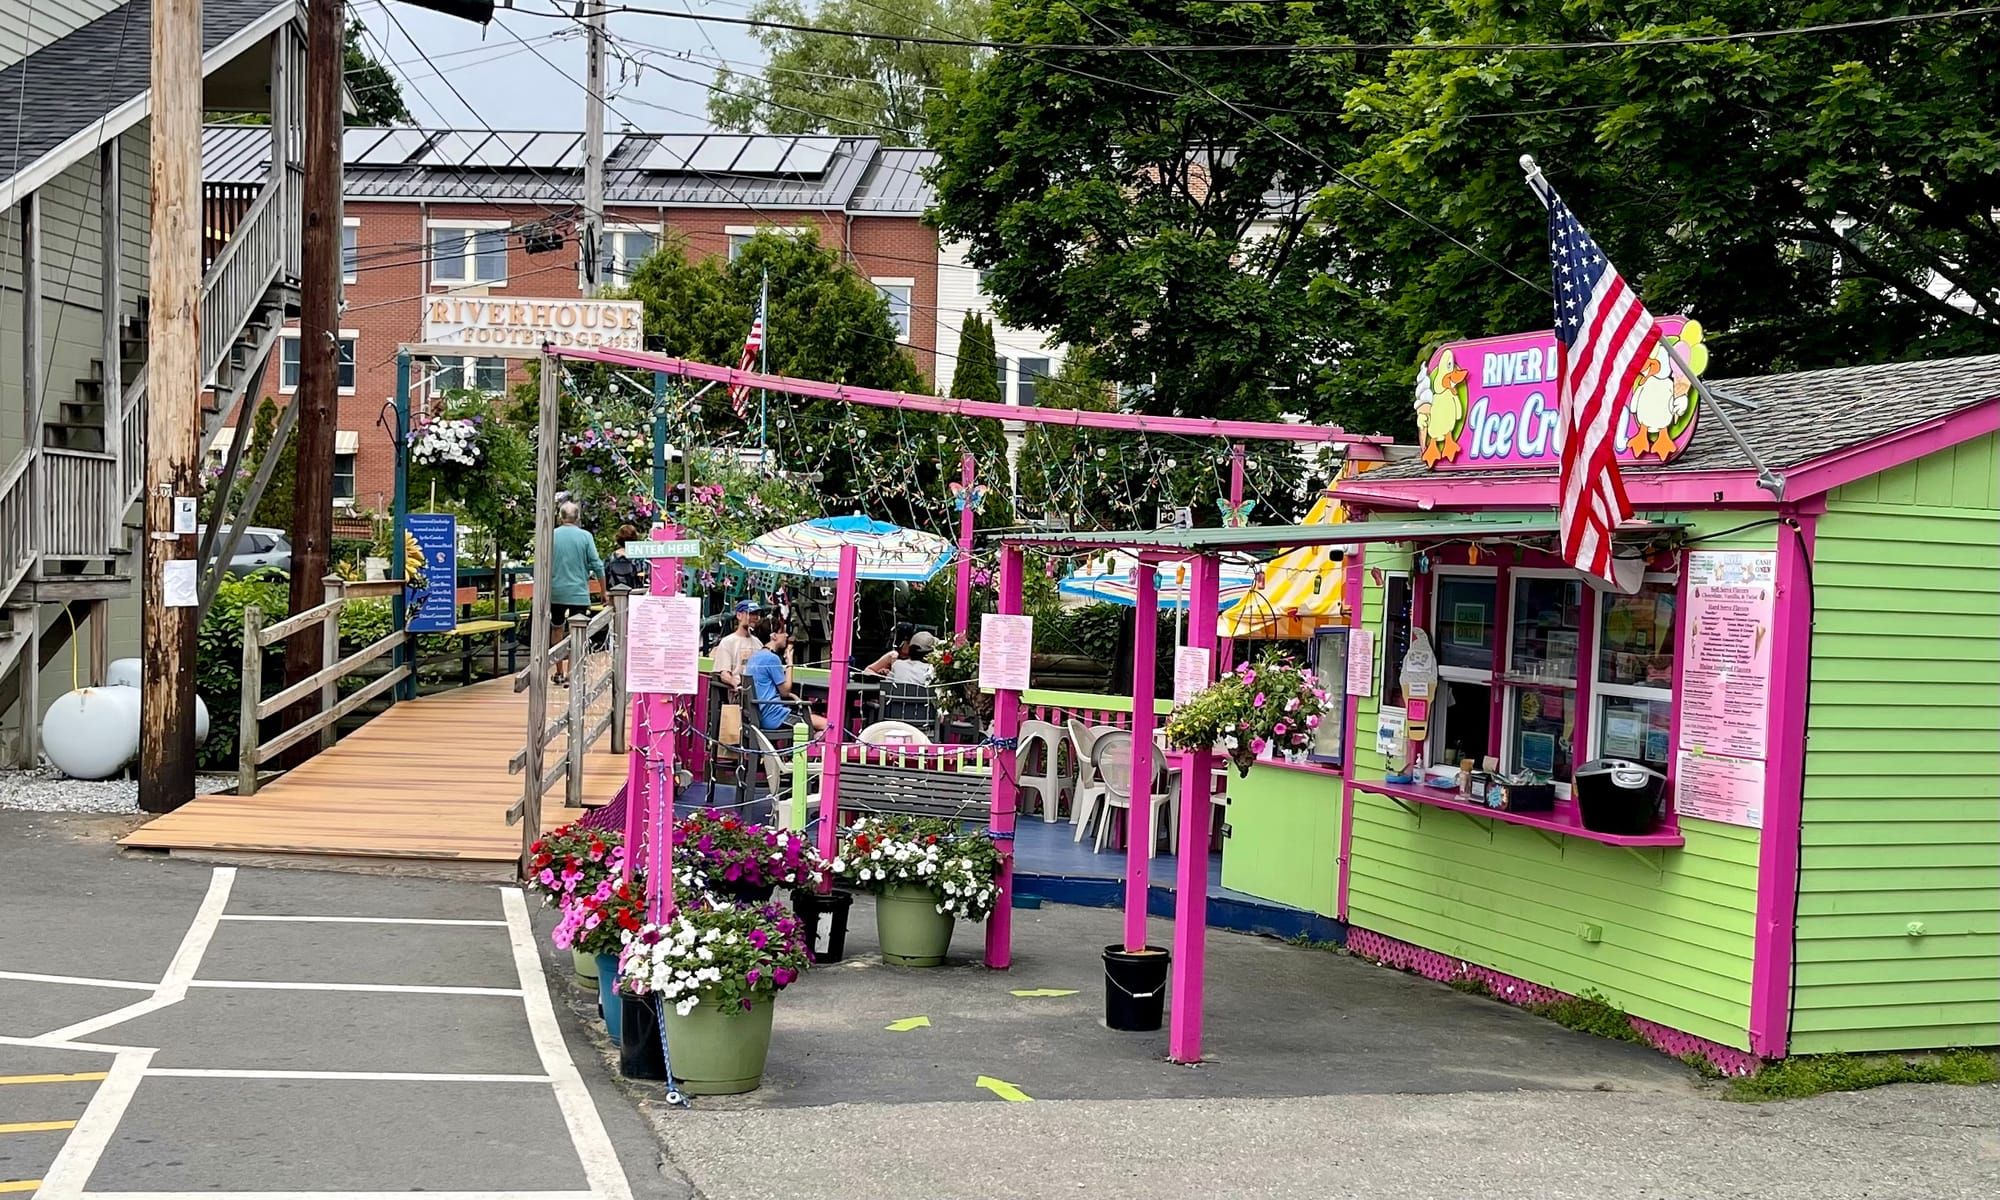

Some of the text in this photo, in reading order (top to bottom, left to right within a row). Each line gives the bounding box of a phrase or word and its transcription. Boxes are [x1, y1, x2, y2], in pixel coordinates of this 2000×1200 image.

[431, 300, 638, 329] RIVERHOUSE
[1482, 347, 1544, 387] RIVER
[1468, 395, 1514, 460] Ice
[627, 543, 698, 556] ENTER HERE
